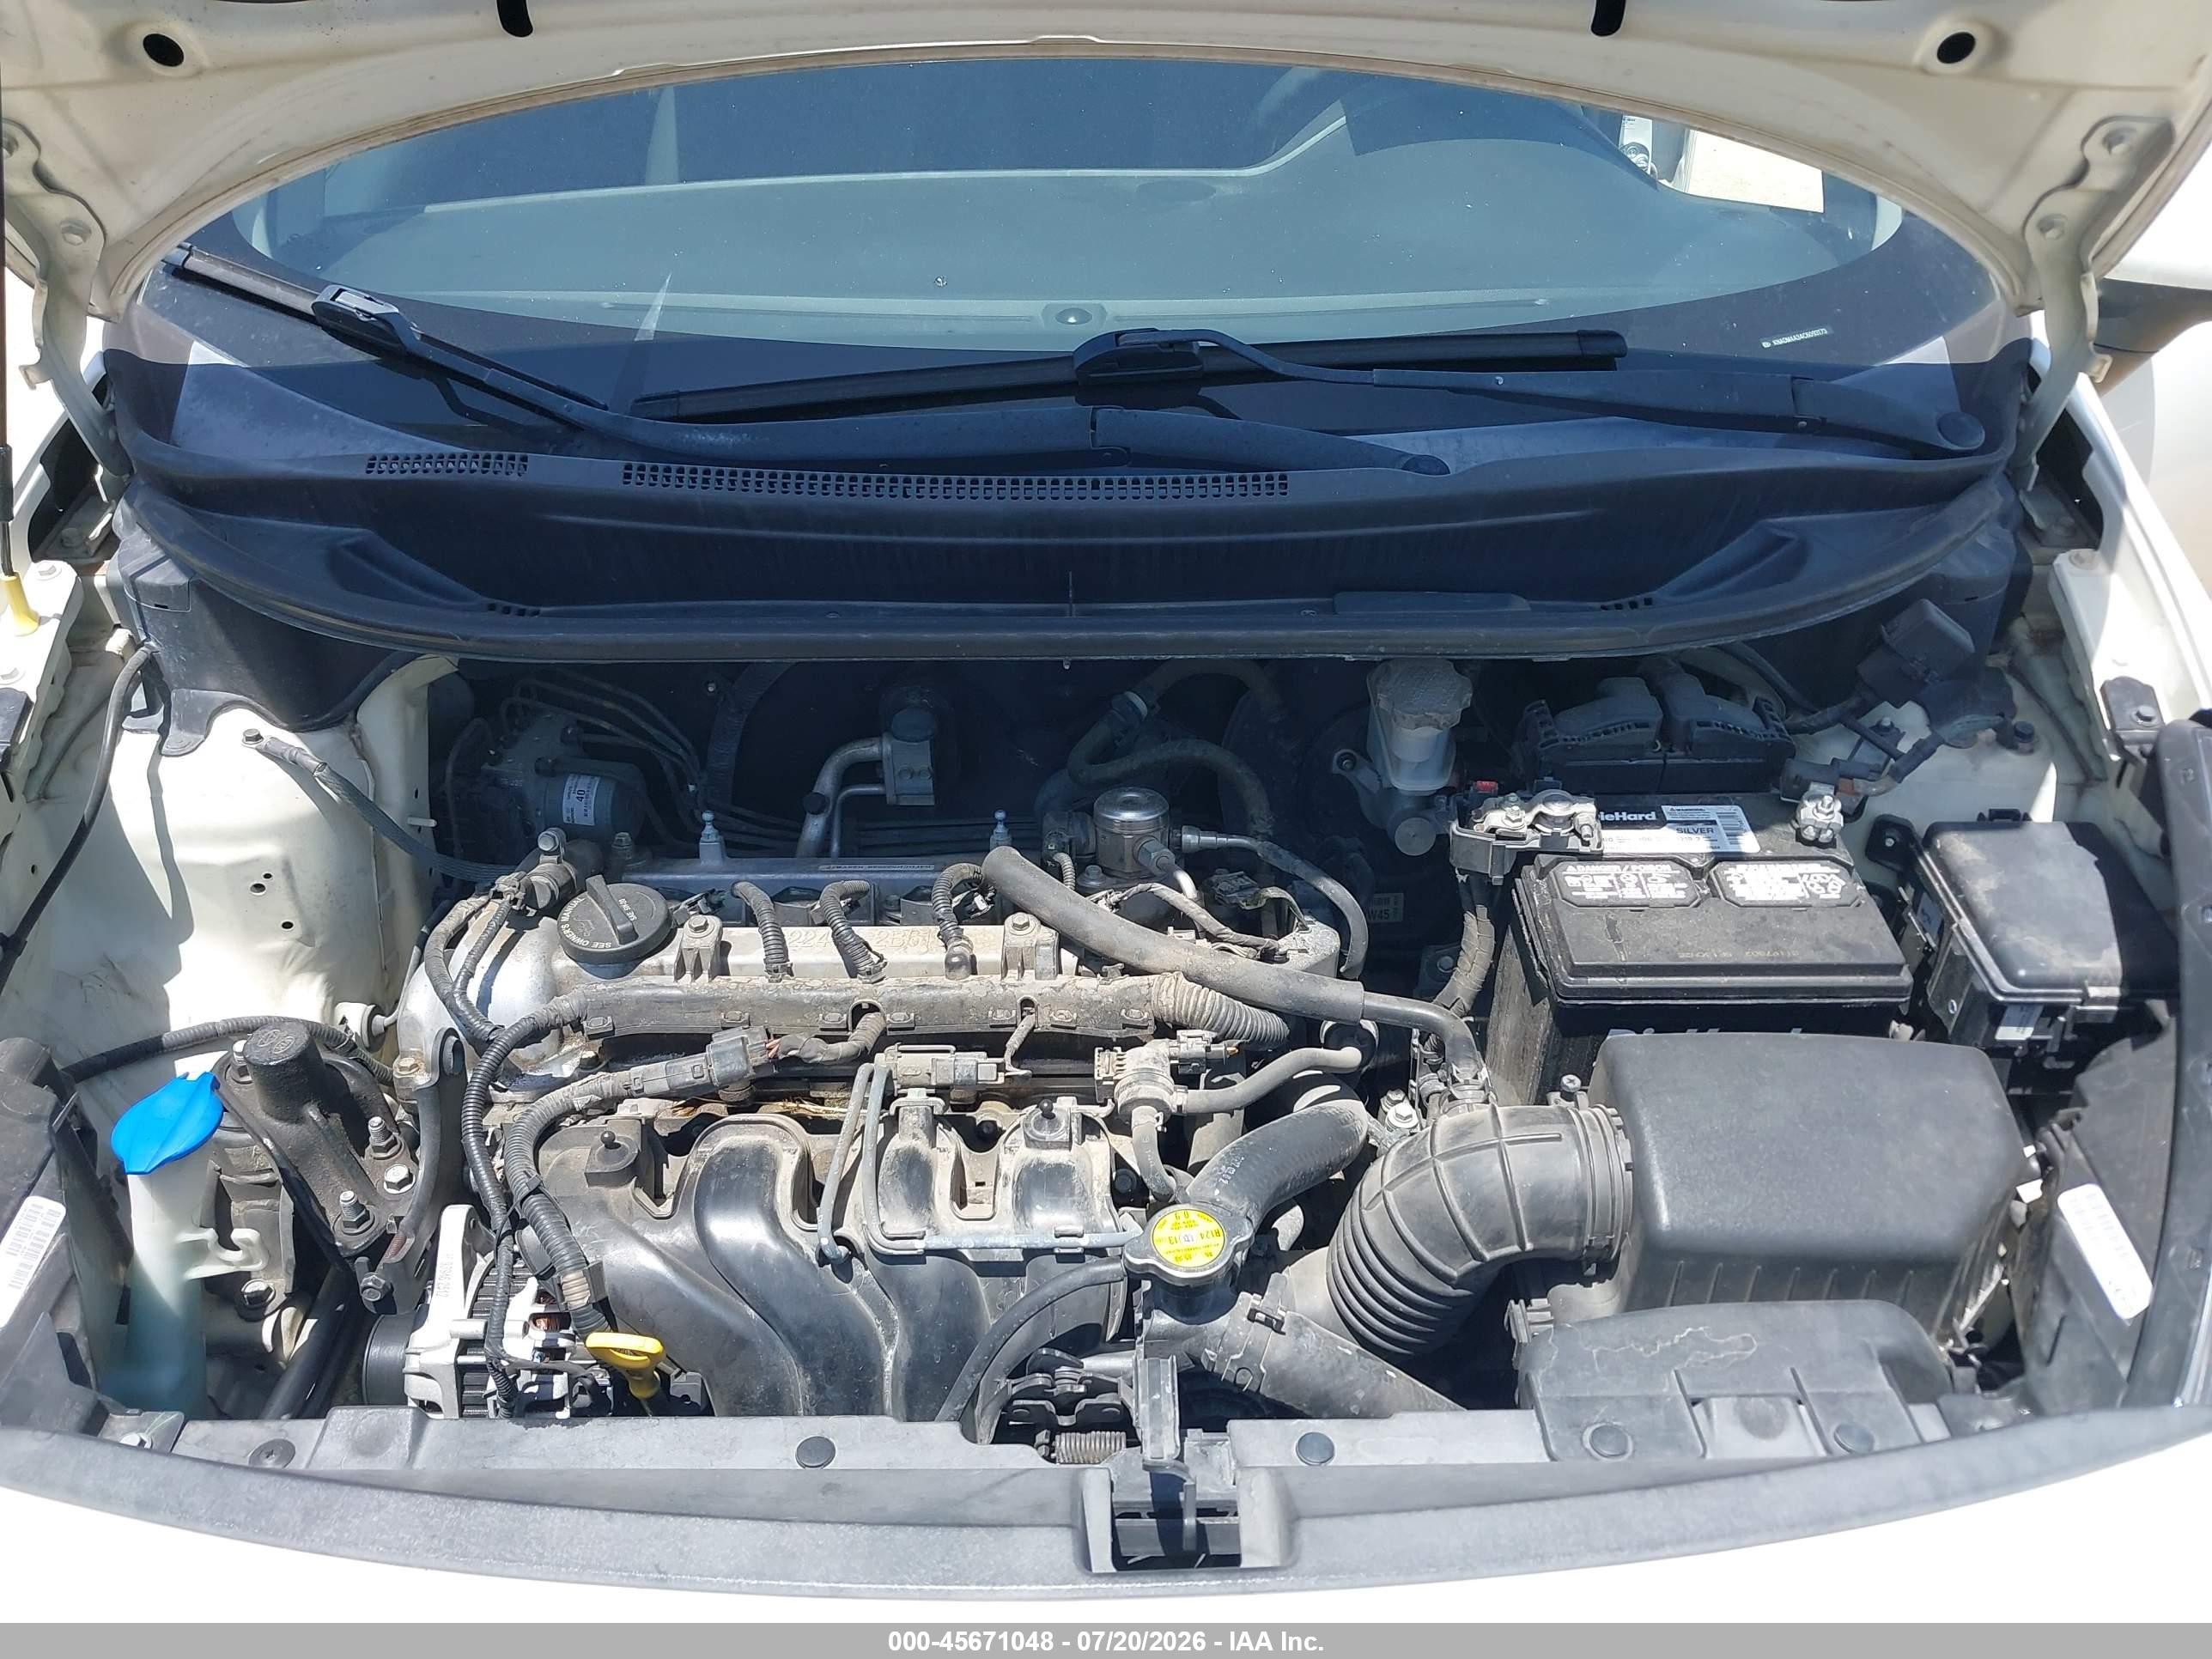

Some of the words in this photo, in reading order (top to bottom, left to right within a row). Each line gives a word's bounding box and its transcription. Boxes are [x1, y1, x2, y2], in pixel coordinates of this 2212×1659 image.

[576, 789, 586, 802] 40
[1598, 811, 1656, 822] ieHard
[561, 897, 586, 922] MANUAL
